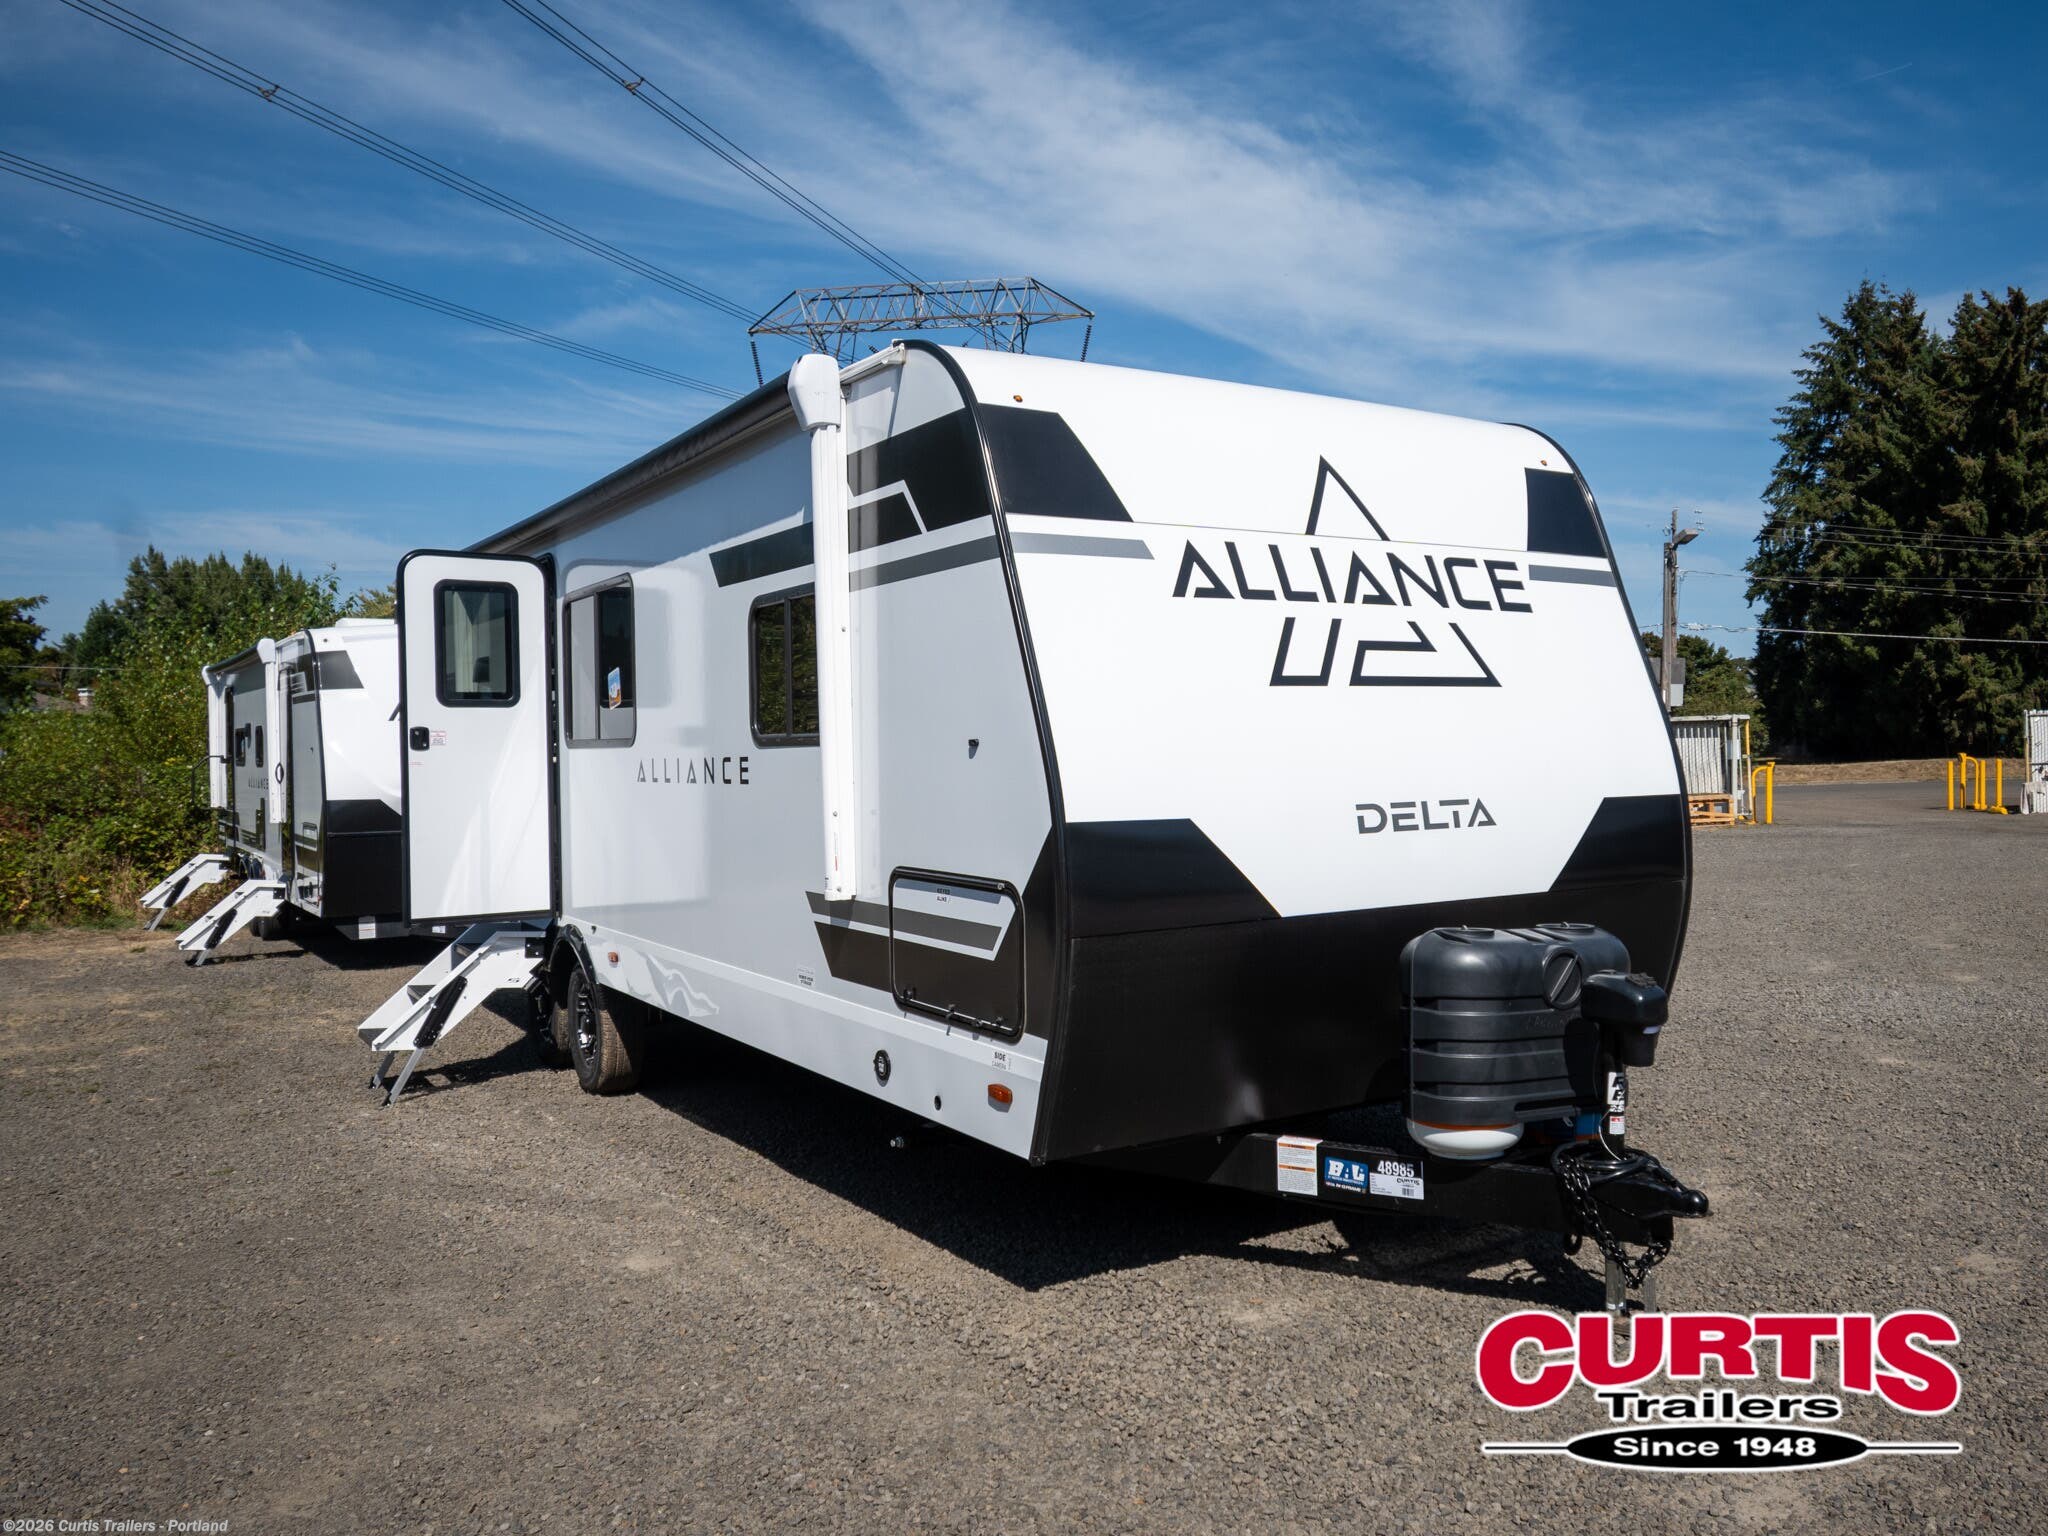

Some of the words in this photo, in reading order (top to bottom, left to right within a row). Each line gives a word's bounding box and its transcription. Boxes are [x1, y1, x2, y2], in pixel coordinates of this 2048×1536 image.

[1172, 539, 1534, 613] ALLIANCE
[637, 757, 749, 784] ALLIANCE
[1355, 797, 1497, 835] DELTA
[1377, 1160, 1415, 1178] 48985
